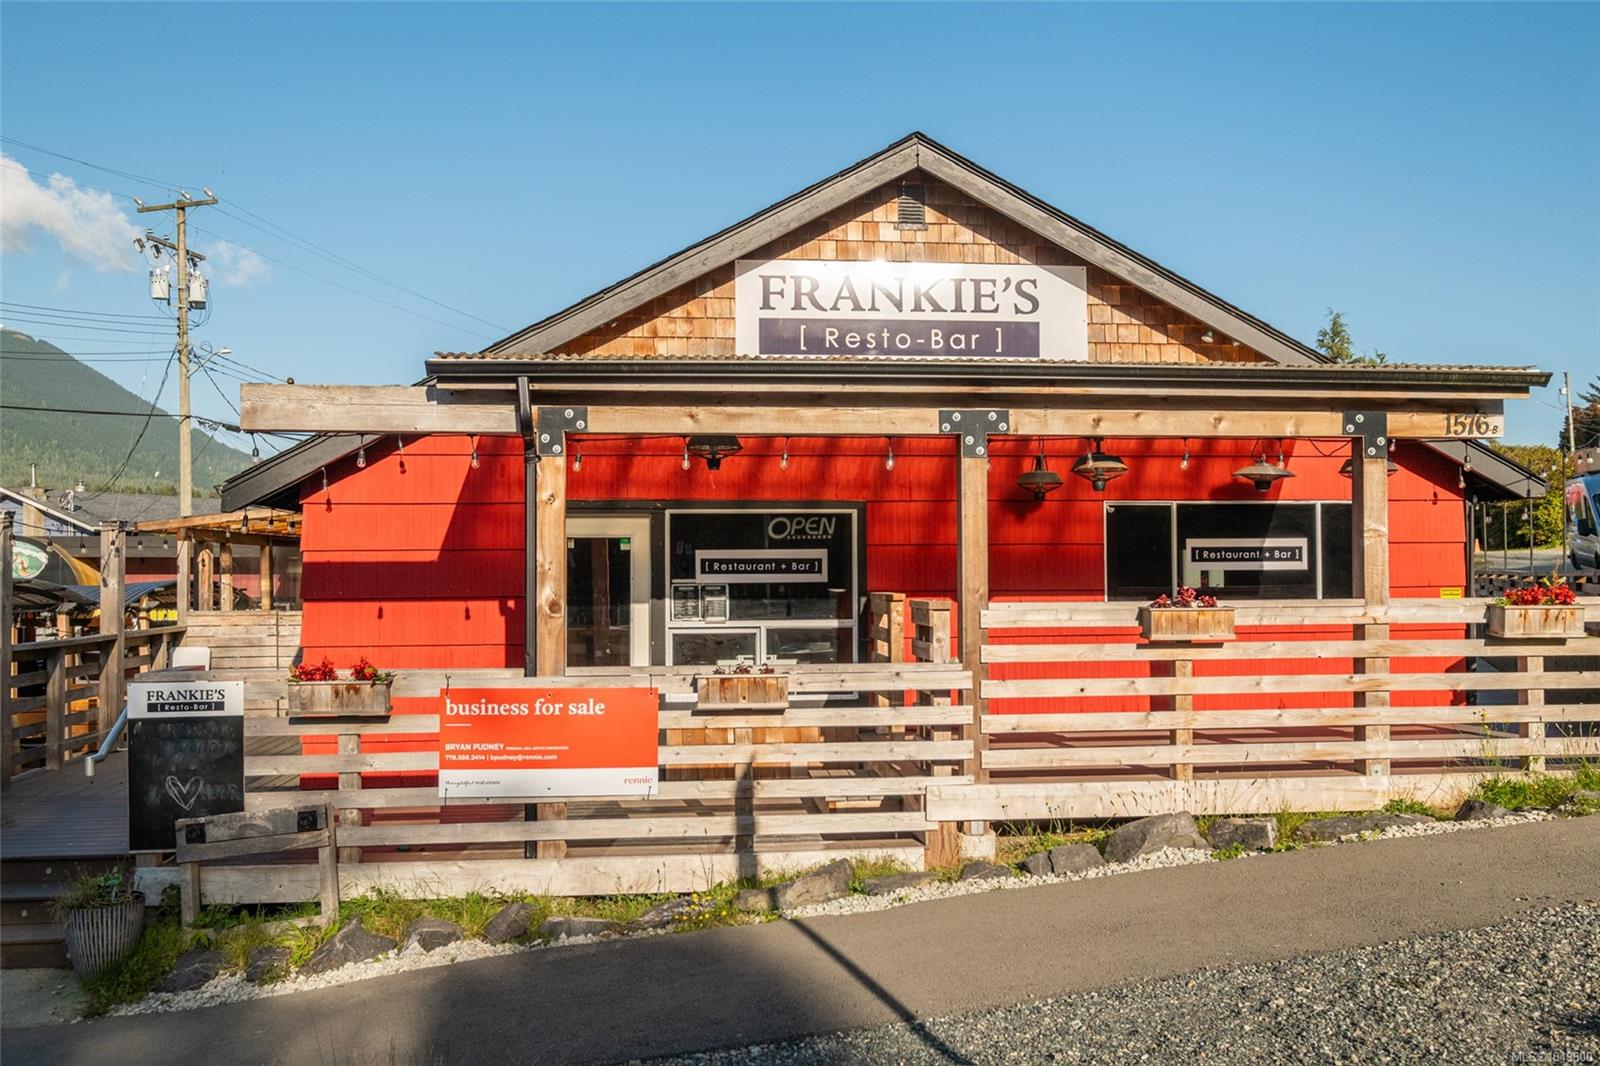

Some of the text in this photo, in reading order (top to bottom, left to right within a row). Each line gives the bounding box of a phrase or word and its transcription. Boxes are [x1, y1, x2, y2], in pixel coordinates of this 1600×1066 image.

[759, 274, 1040, 315] FRANKIE'S
[825, 326, 981, 350] Resto-Bar
[768, 516, 836, 539] OPEN
[1203, 550, 1260, 559] Restaurant
[1274, 550, 1292, 559] Bar
[713, 561, 776, 571] Restaurant
[791, 561, 810, 571] Bar
[146, 689, 226, 702] FRANKIE'S
[164, 703, 209, 711] Resto-Bar
[445, 698, 606, 716] business for sale
[445, 743, 472, 751] BRYAN
[472, 743, 505, 751] PUDNEY
[623, 775, 653, 785] rennie
